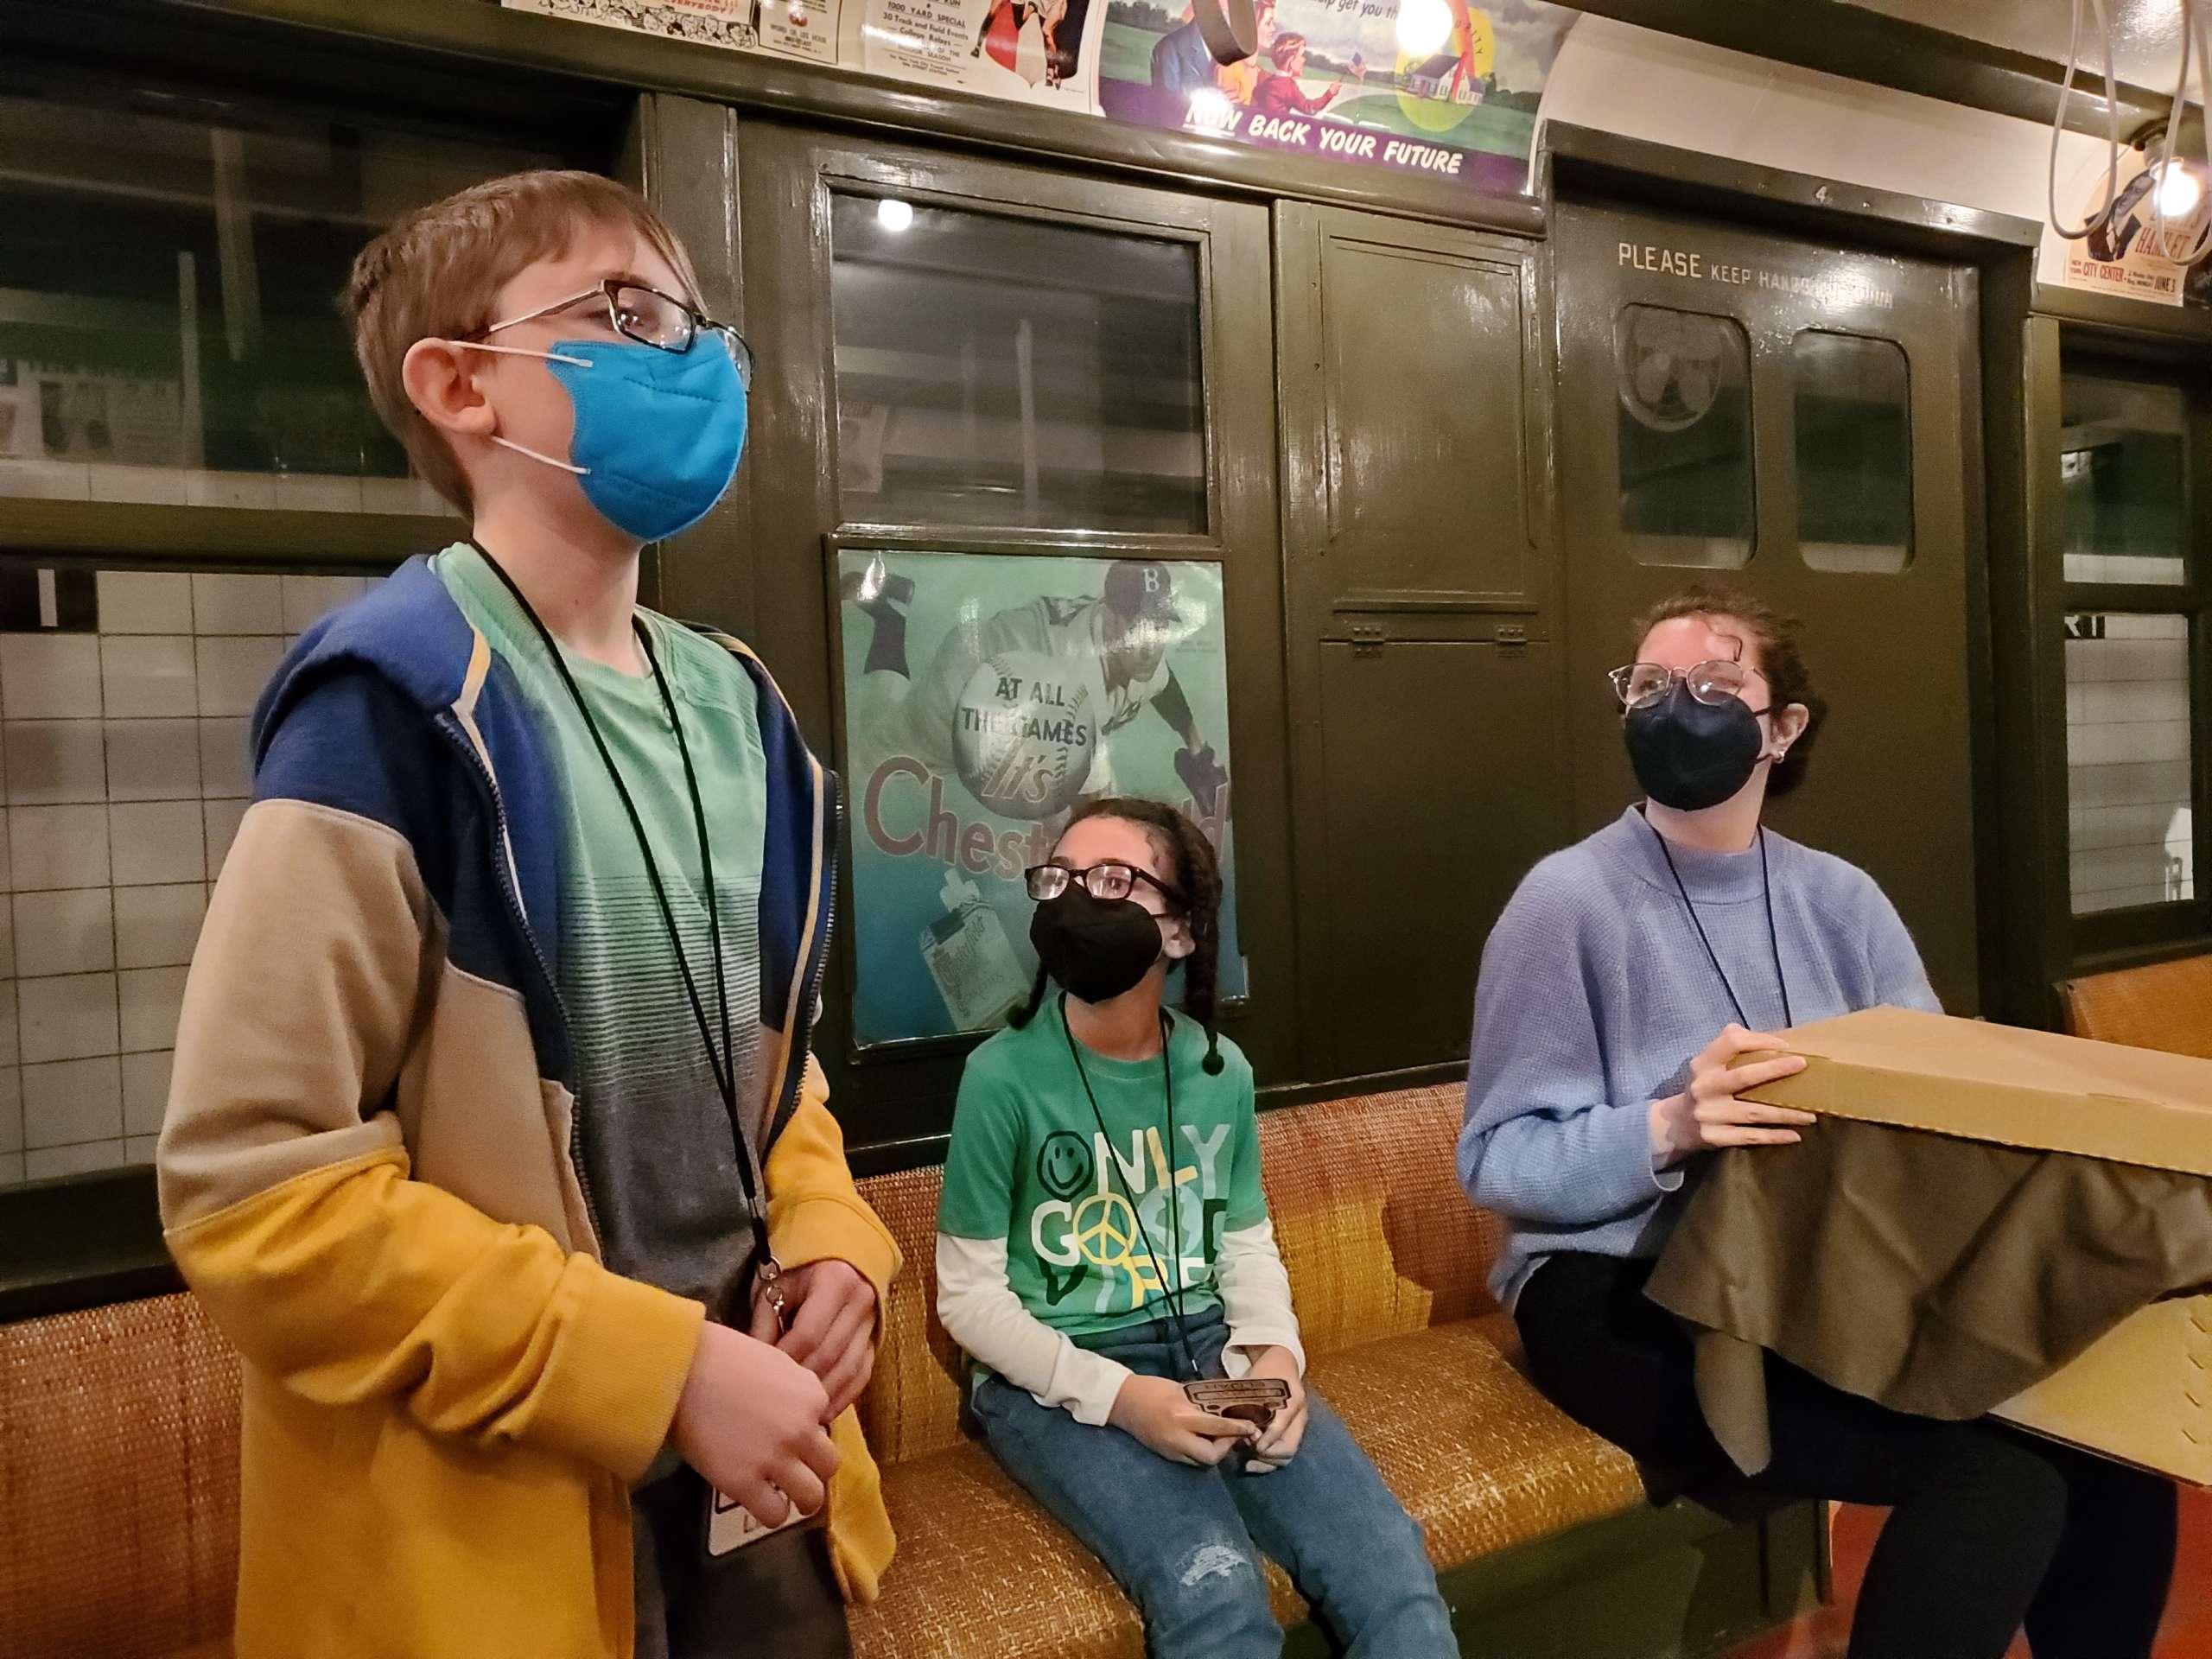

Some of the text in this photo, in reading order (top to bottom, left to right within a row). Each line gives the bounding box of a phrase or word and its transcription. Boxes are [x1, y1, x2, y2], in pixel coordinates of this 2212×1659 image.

[887, 1, 966, 28] 1000 YARD SPECIAL
[1337, 0, 1357, 12] get
[1359, 3, 1382, 18] you
[1185, 106, 1463, 174] NOW BACK YOUR FUTURE
[1815, 186, 1827, 204] 4
[1618, 243, 1702, 278] PLEASE
[1711, 263, 1751, 284] KEEP
[2101, 264, 2124, 283] CENTER
[1143, 569, 1160, 592] B
[995, 677, 1065, 707] AT ALL
[962, 707, 999, 734] TH
[981, 737, 1053, 803] It's
